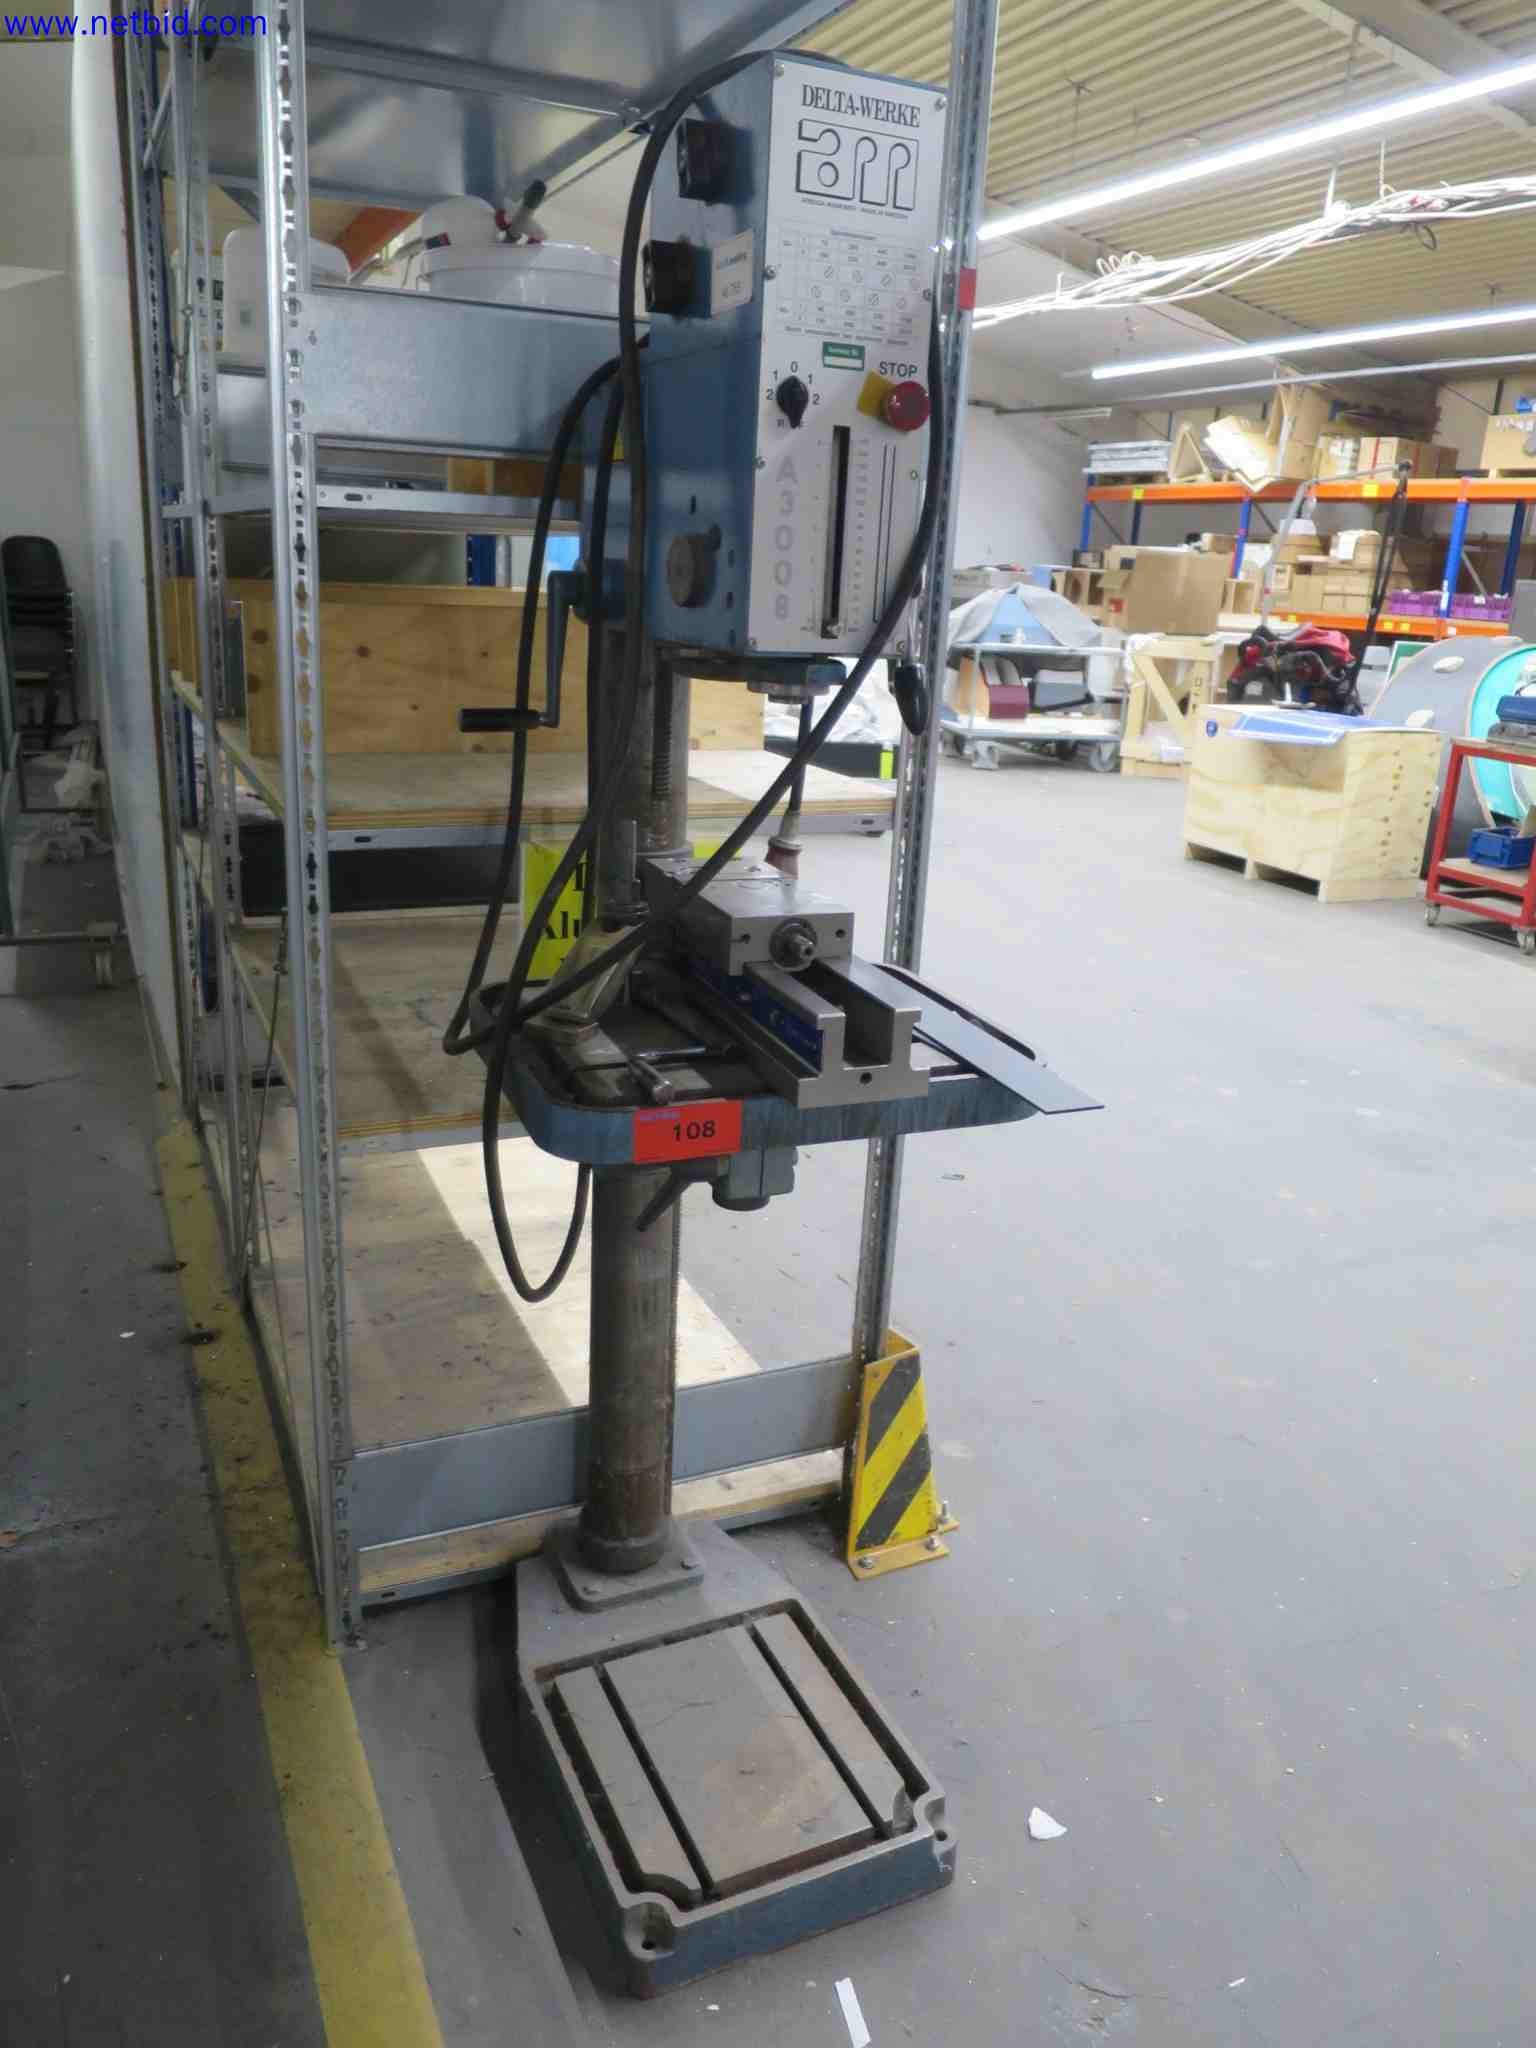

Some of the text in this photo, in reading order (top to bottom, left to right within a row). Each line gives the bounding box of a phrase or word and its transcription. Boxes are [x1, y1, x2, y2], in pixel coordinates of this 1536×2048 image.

[801, 84, 920, 128] DELTA-WERKE
[790, 361, 799, 373] 0
[879, 361, 918, 378] STOP
[766, 388, 774, 400] 2
[812, 393, 821, 405] 2
[673, 1120, 716, 1141] 108
